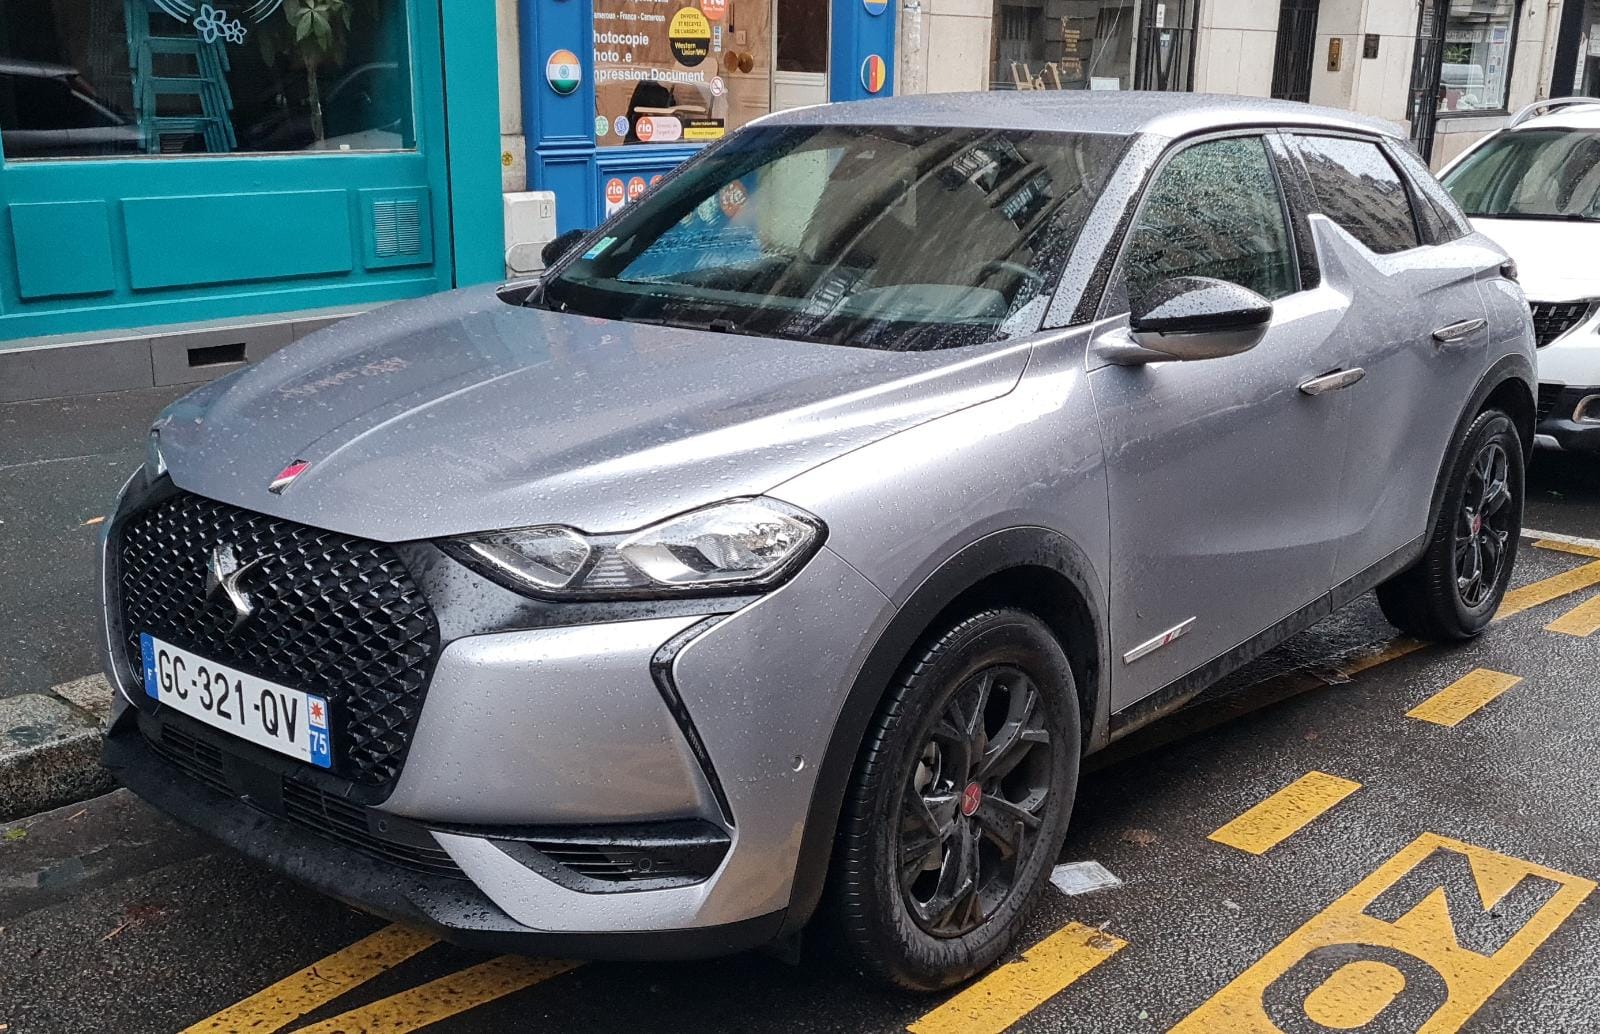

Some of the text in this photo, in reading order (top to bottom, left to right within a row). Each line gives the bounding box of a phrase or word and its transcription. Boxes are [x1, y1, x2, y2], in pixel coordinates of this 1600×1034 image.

[594, 31, 649, 46] hotocopie
[594, 48, 619, 61] hoto
[637, 120, 652, 133] ria
[607, 182, 623, 195] ria
[147, 668, 153, 680] F
[158, 649, 298, 743] GC-321-QV
[309, 730, 327, 755] 75
